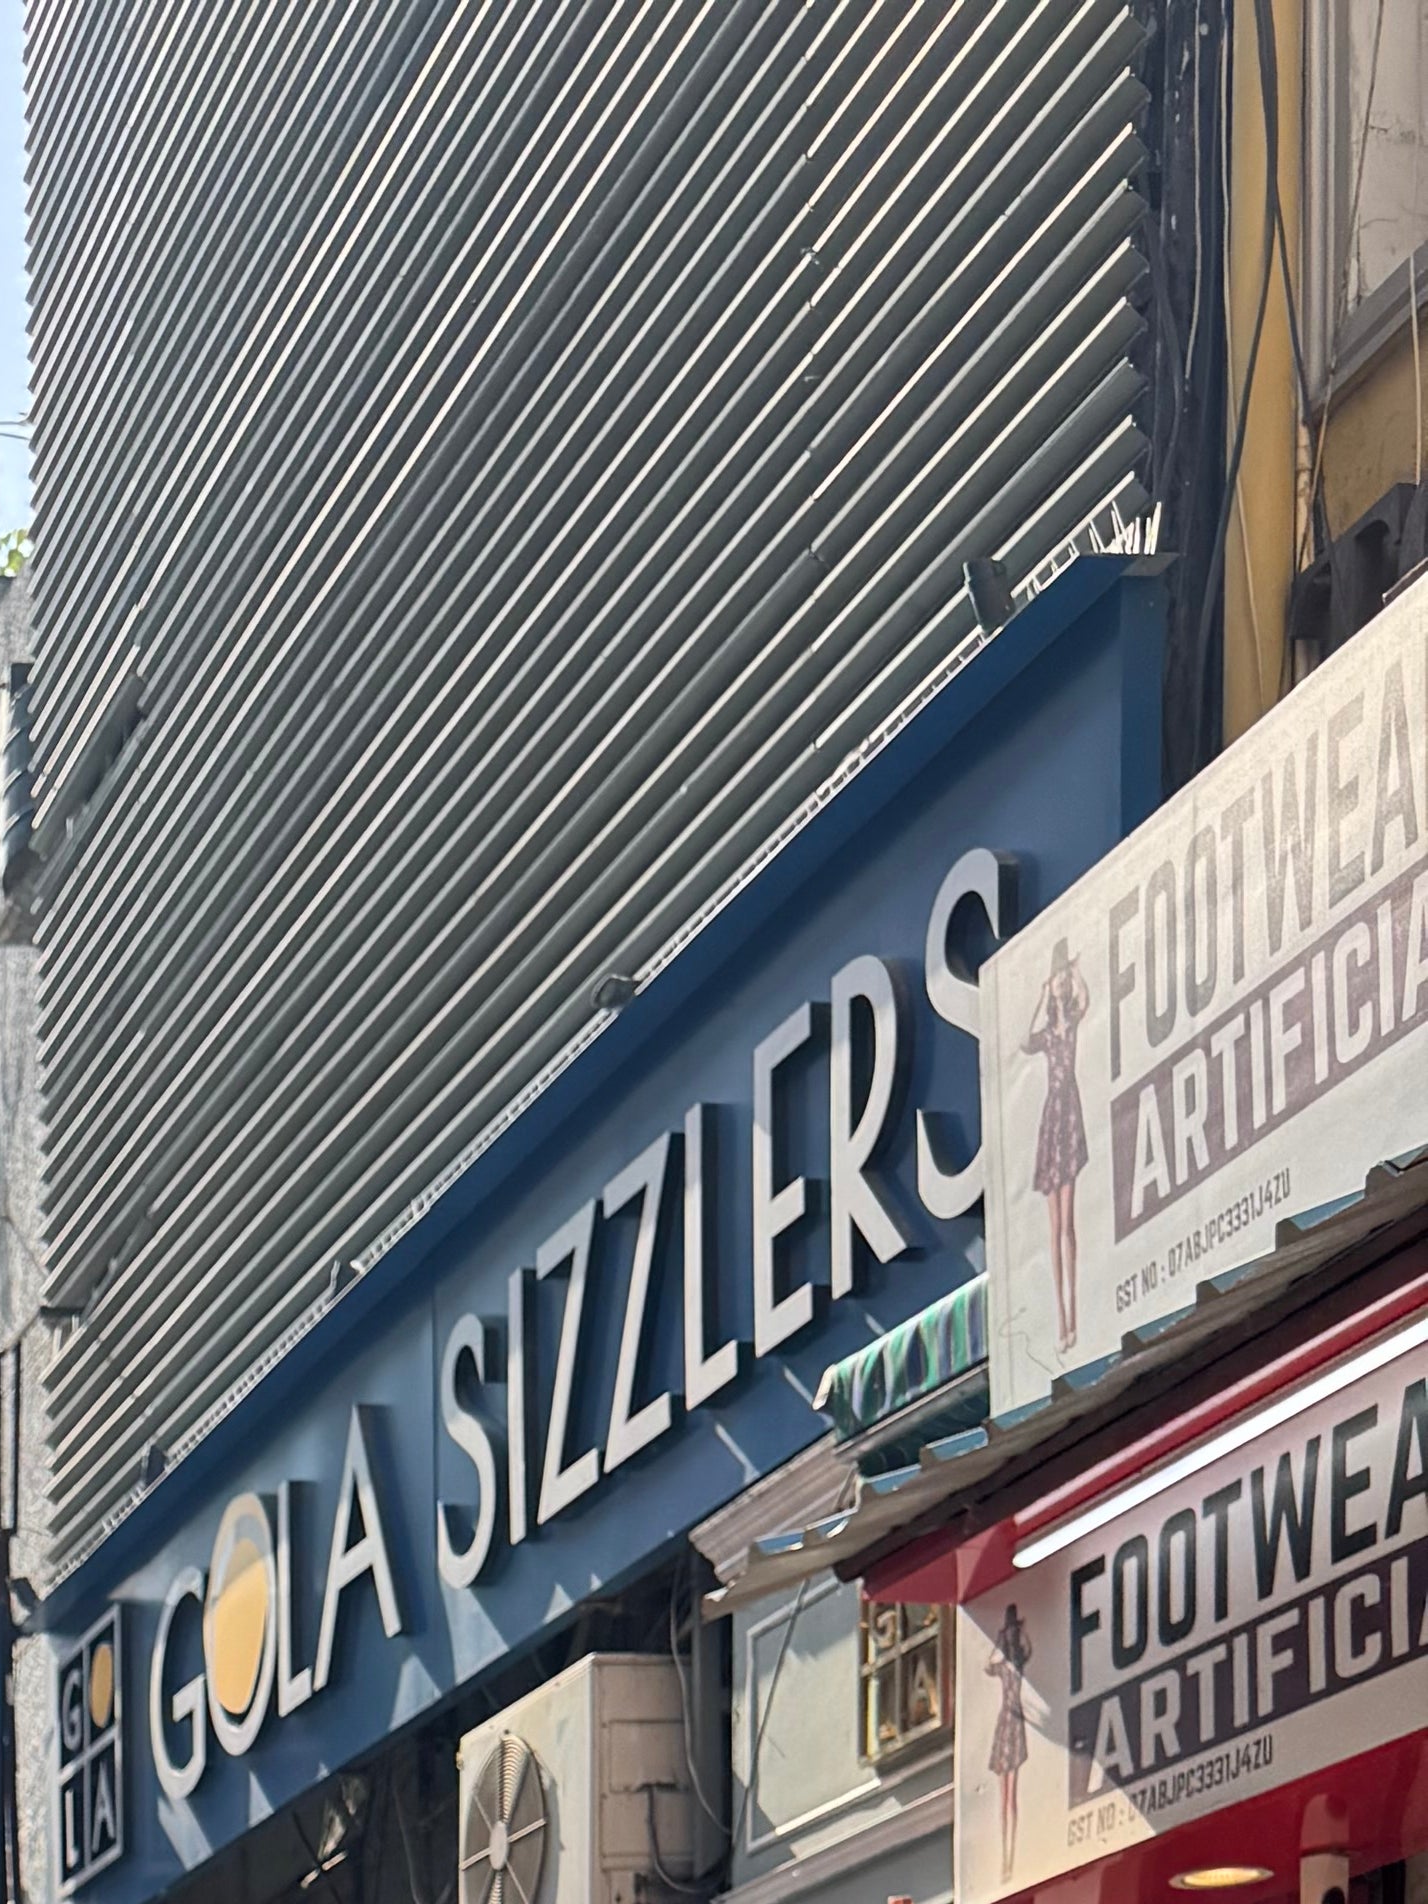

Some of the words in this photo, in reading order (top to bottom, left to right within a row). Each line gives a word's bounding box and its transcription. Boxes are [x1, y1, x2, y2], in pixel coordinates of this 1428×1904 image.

[1108, 645, 1428, 1083] FOOTWEA
[149, 1403, 405, 1802] GOLA
[436, 846, 1004, 1591] SIZZLERS
[1116, 1273, 1138, 1313] GST
[1087, 1556, 1428, 1794] ARTIFICI
[1067, 1809, 1093, 1847] GST
